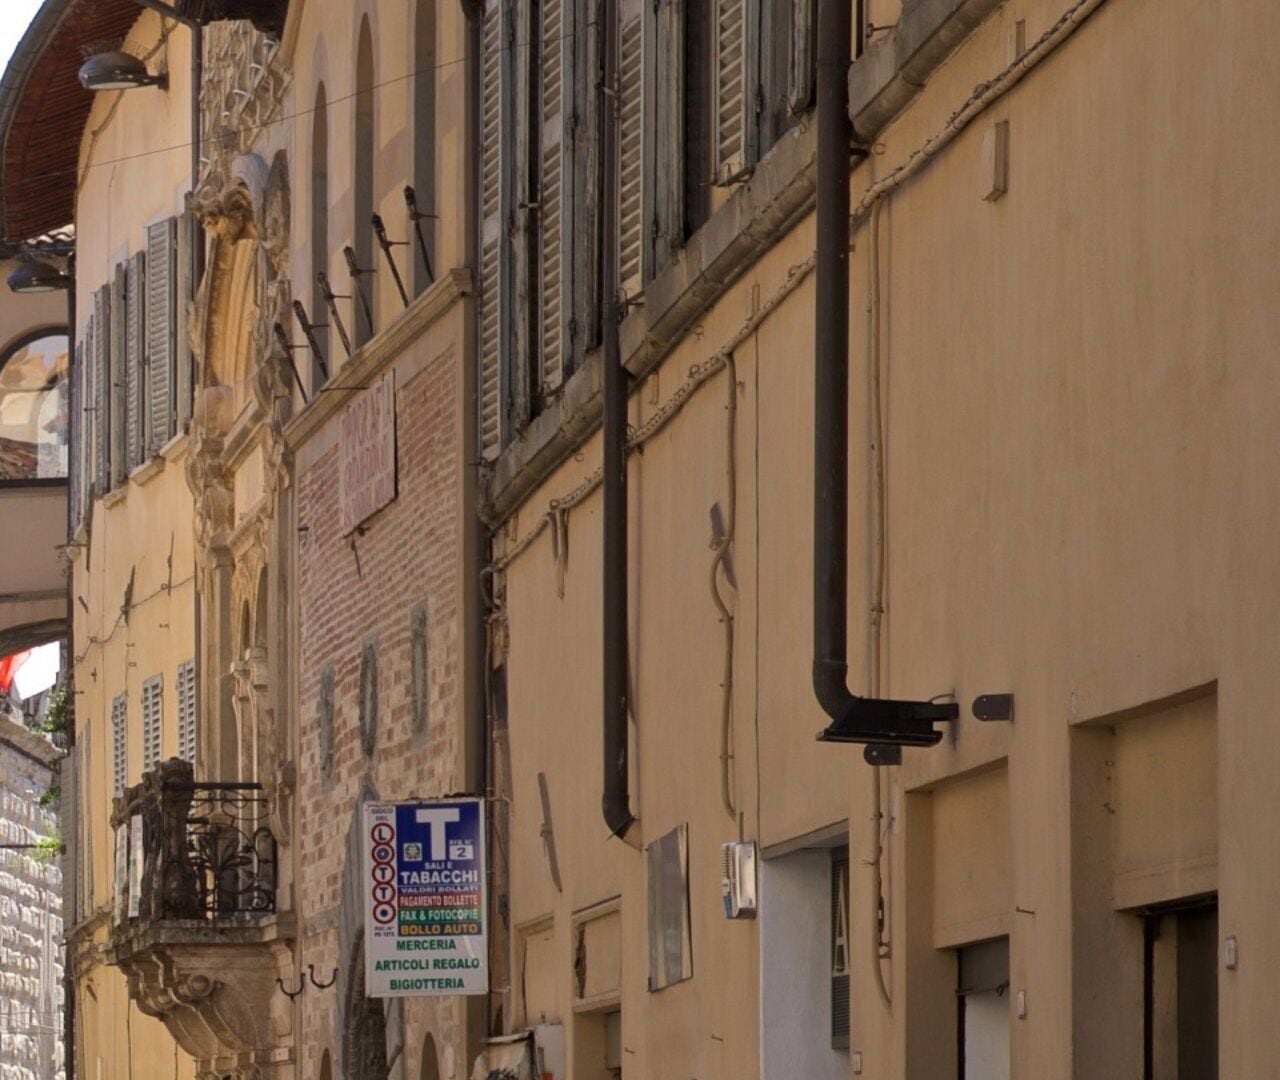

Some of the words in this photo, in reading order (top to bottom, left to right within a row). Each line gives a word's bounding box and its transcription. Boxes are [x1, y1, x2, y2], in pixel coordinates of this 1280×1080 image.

[416, 807, 460, 861] T
[457, 847, 467, 858] 2
[424, 861, 445, 870] SALI
[447, 861, 454, 869] E
[400, 869, 479, 884] TABACCHI
[400, 895, 442, 907] PAGAMENTO
[443, 894, 479, 906] BOLLETTE
[400, 911, 417, 920] FAX
[419, 911, 426, 920] &
[428, 909, 479, 919] FOTOCOPIE
[400, 925, 441, 935] BOLLO
[444, 923, 478, 934] AUTO
[396, 939, 457, 951] MERCERIA
[375, 959, 429, 971] ARTICOLI
[433, 958, 480, 970] REGALO
[389, 978, 465, 991] BIGIOTTERIA
